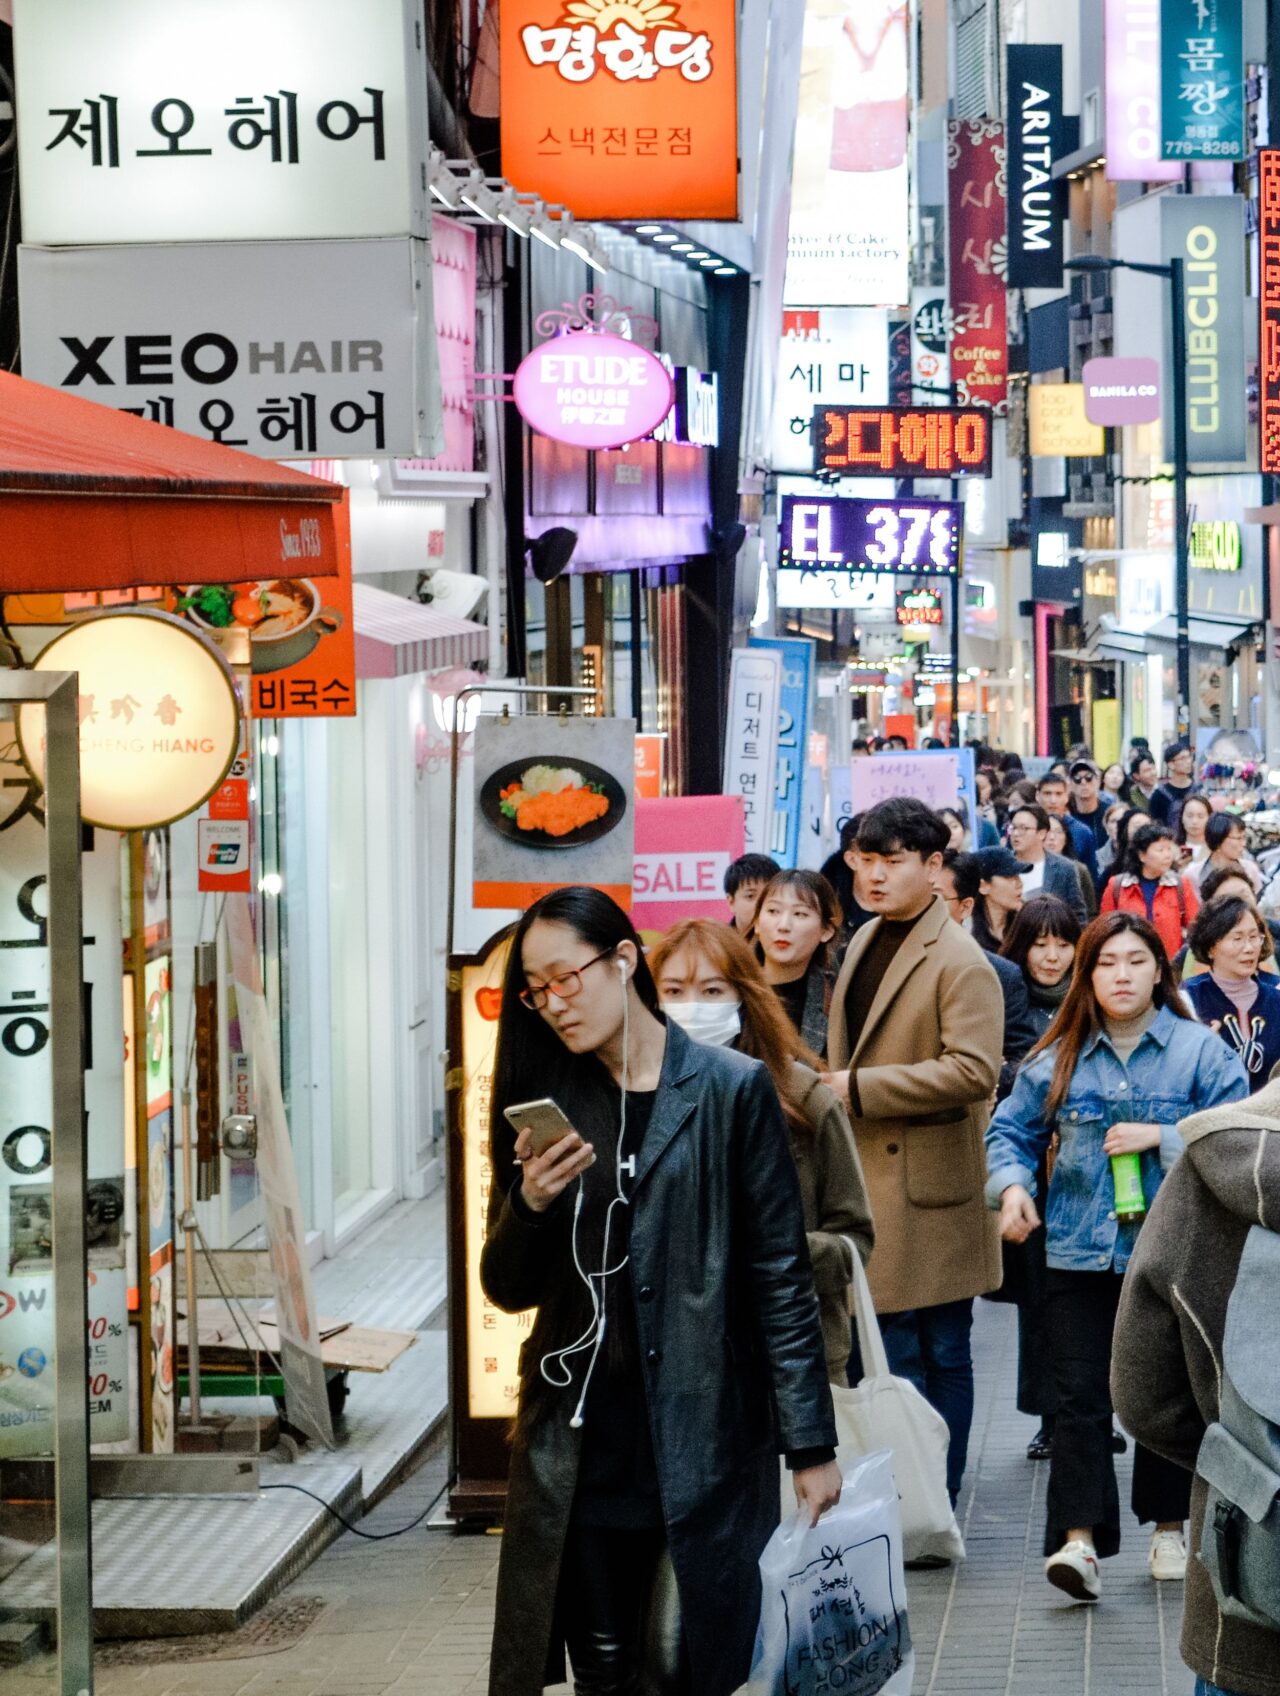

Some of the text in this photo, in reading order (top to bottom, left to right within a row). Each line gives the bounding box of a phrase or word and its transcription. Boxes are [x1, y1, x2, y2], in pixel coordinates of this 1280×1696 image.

[45, 87, 386, 168] 제오헤어
[537, 127, 692, 156] 스낵전문점
[1022, 82, 1052, 250] ARITAUM
[1186, 225, 1219, 433] CLUBCLIO
[59, 332, 384, 386] XEO HAIR
[953, 346, 1002, 361] Coffee
[540, 354, 648, 386] ETUDE
[966, 372, 1004, 386] Cake
[557, 388, 629, 405] HOUSE
[259, 680, 350, 711] 비국수
[740, 692, 763, 760] 디저트
[152, 737, 216, 754] HIANG
[633, 861, 716, 894] SALE
[797, 1614, 889, 1670] FASHION
